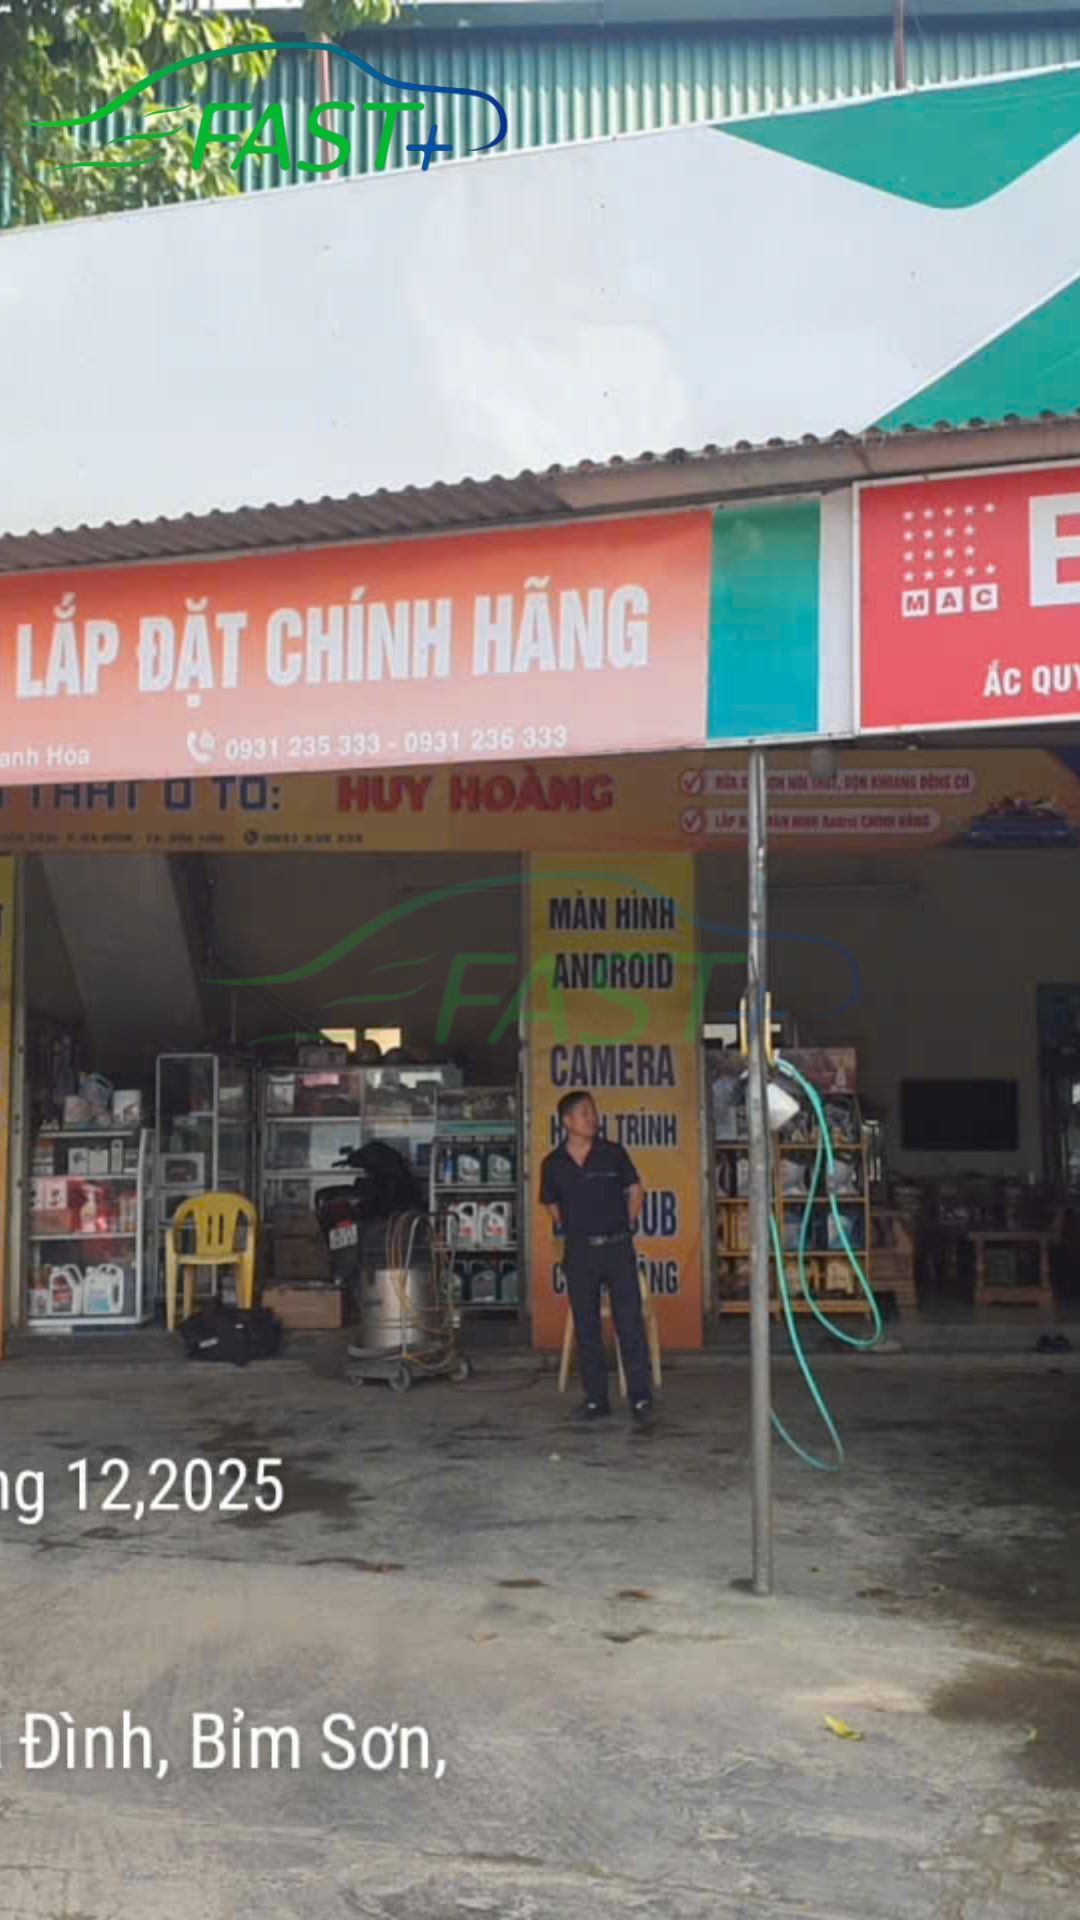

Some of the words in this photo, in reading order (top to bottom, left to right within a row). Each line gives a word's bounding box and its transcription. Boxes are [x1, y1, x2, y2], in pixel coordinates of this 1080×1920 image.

[16, 592, 119, 698] LẮP
[136, 597, 248, 708] ĐẶT
[266, 585, 452, 686] CHÍNH
[472, 576, 649, 676] HÃNG
[225, 737, 279, 761] 0931
[339, 732, 381, 755] 333
[404, 730, 460, 753] 0931
[523, 725, 569, 749] 333
[337, 774, 431, 813] HUY
[450, 764, 614, 813] HOÀNG
[549, 889, 606, 930] MÀN
[615, 888, 675, 930] HÌNH
[552, 952, 674, 990] ANDROID
[550, 1044, 676, 1087] CAMERA
[615, 1107, 677, 1147] TRÌNH
